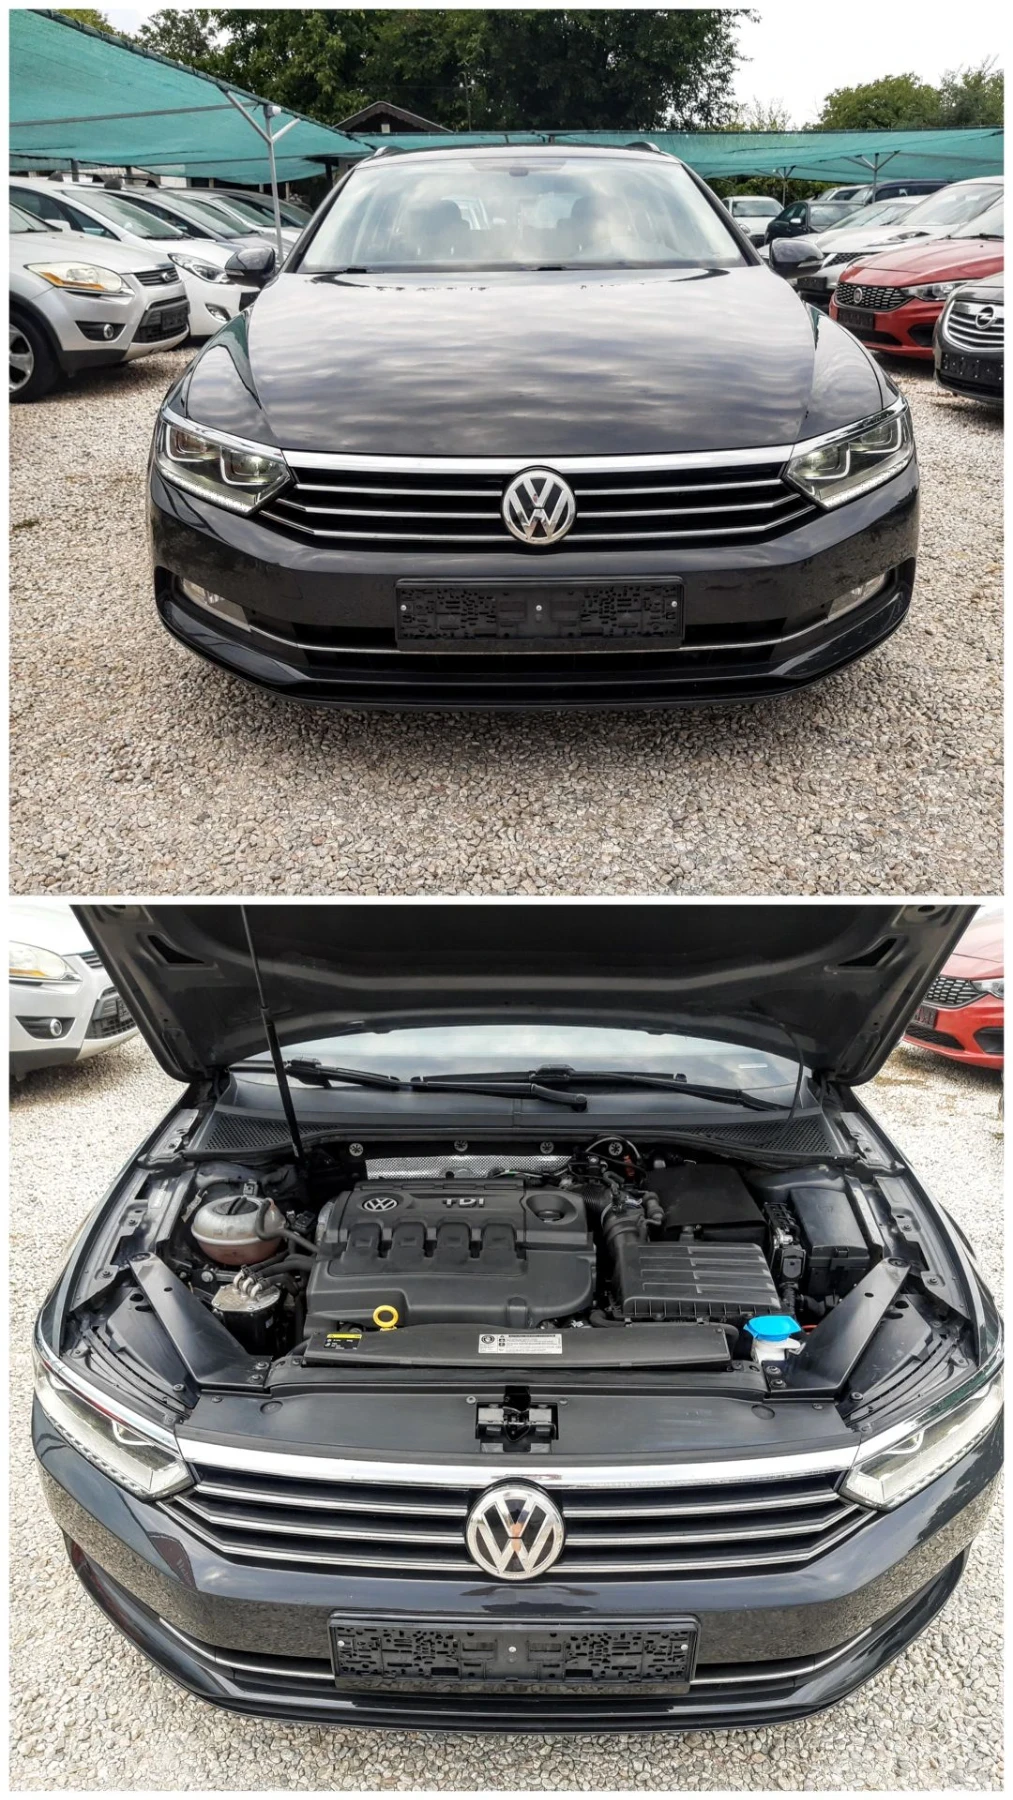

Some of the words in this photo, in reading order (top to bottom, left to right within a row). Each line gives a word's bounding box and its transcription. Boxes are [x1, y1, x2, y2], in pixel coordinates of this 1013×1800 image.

[504, 471, 574, 543] VW
[364, 1198, 397, 1211] VW
[443, 1197, 484, 1207] TDI
[468, 1486, 563, 1579] VW
